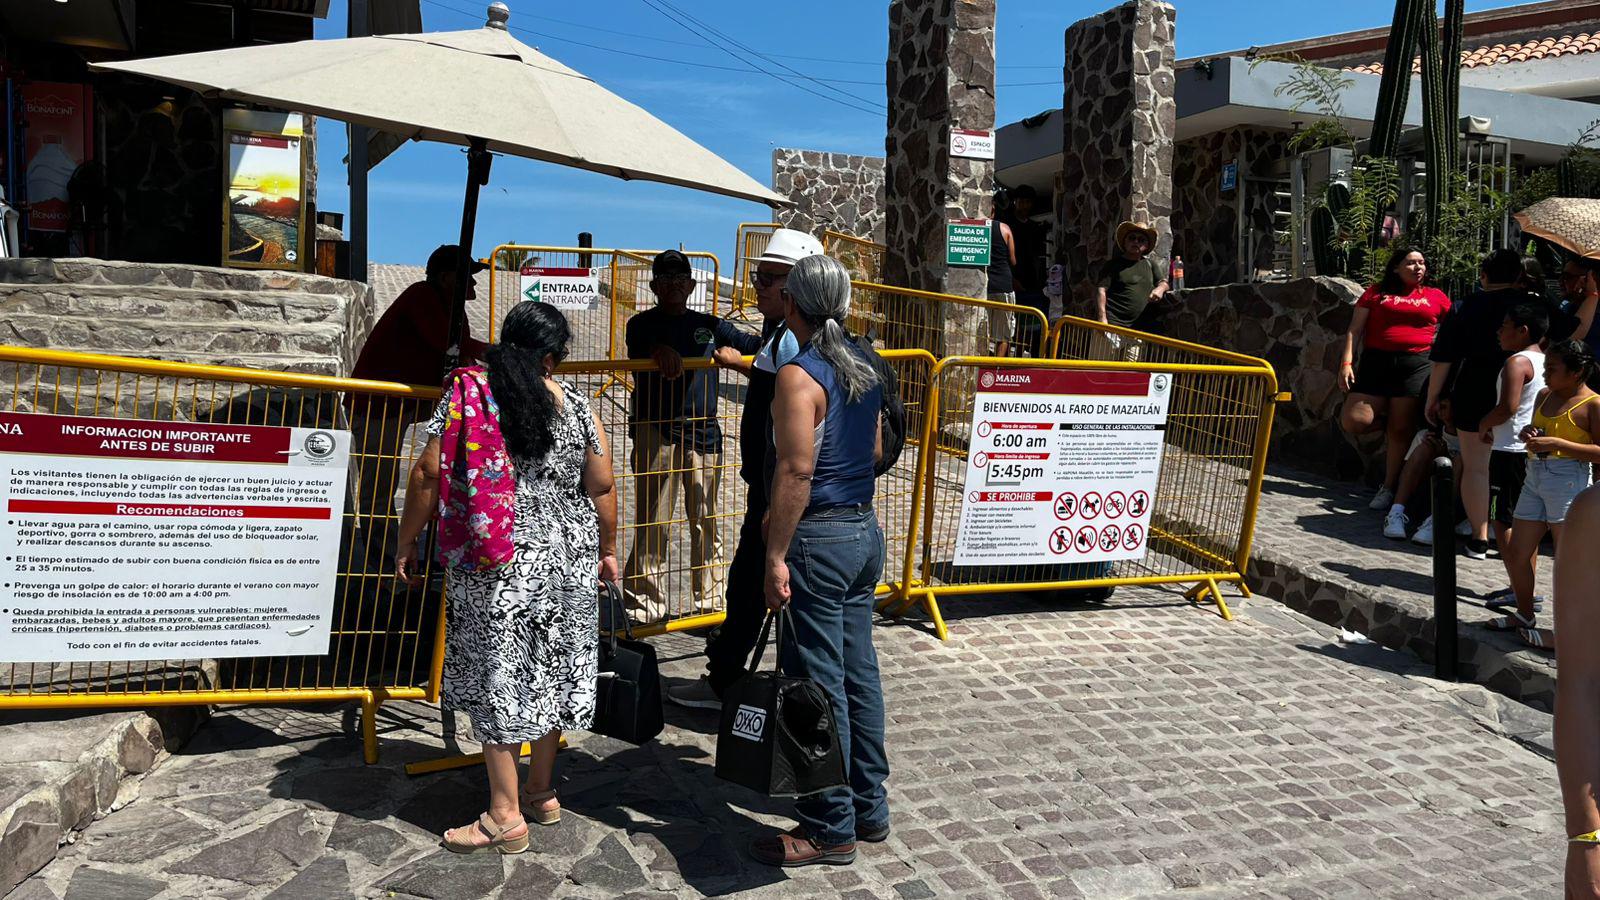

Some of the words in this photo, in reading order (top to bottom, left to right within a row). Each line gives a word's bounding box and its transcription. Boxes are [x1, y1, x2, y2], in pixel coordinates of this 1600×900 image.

[542, 284, 594, 293] ENTRADA
[542, 295, 596, 304] ENTRANCE
[996, 375, 1031, 383] MARINA
[983, 402, 1052, 413] BIENVENIDOS
[1054, 404, 1066, 414] AL
[1069, 404, 1094, 414] FARO
[1096, 404, 1108, 414] DE
[1111, 403, 1160, 415] MAZATLÁN
[61, 426, 162, 438] INFORMACION
[166, 431, 251, 442] IMPORTANTE
[993, 434, 1023, 447] 6:00
[1026, 437, 1046, 447] am
[100, 440, 147, 450] ANTES
[151, 442, 170, 451] DE
[173, 443, 214, 453] SUBIR
[32, 470, 82, 478] visitantes
[130, 473, 182, 483] obligación
[198, 475, 231, 484] ejercer
[271, 478, 296, 486] juicio
[66, 480, 129, 489] responsable
[140, 482, 177, 491] cumplir
[243, 485, 271, 494] reglas
[286, 487, 319, 495] ingreso
[987, 492, 997, 501] SE
[998, 492, 1036, 501] PROHIBE
[116, 505, 244, 516] Recomendaciones
[245, 524, 272, 532] ligera,
[17, 528, 67, 537] deportivo,
[245, 533, 294, 541] bloqueador
[28, 556, 62, 564] tiempo
[14, 581, 60, 590] Prevenga
[78, 582, 105, 591] golpe
[13, 590, 44, 599] riesgo
[735, 711, 762, 733] OXXO
